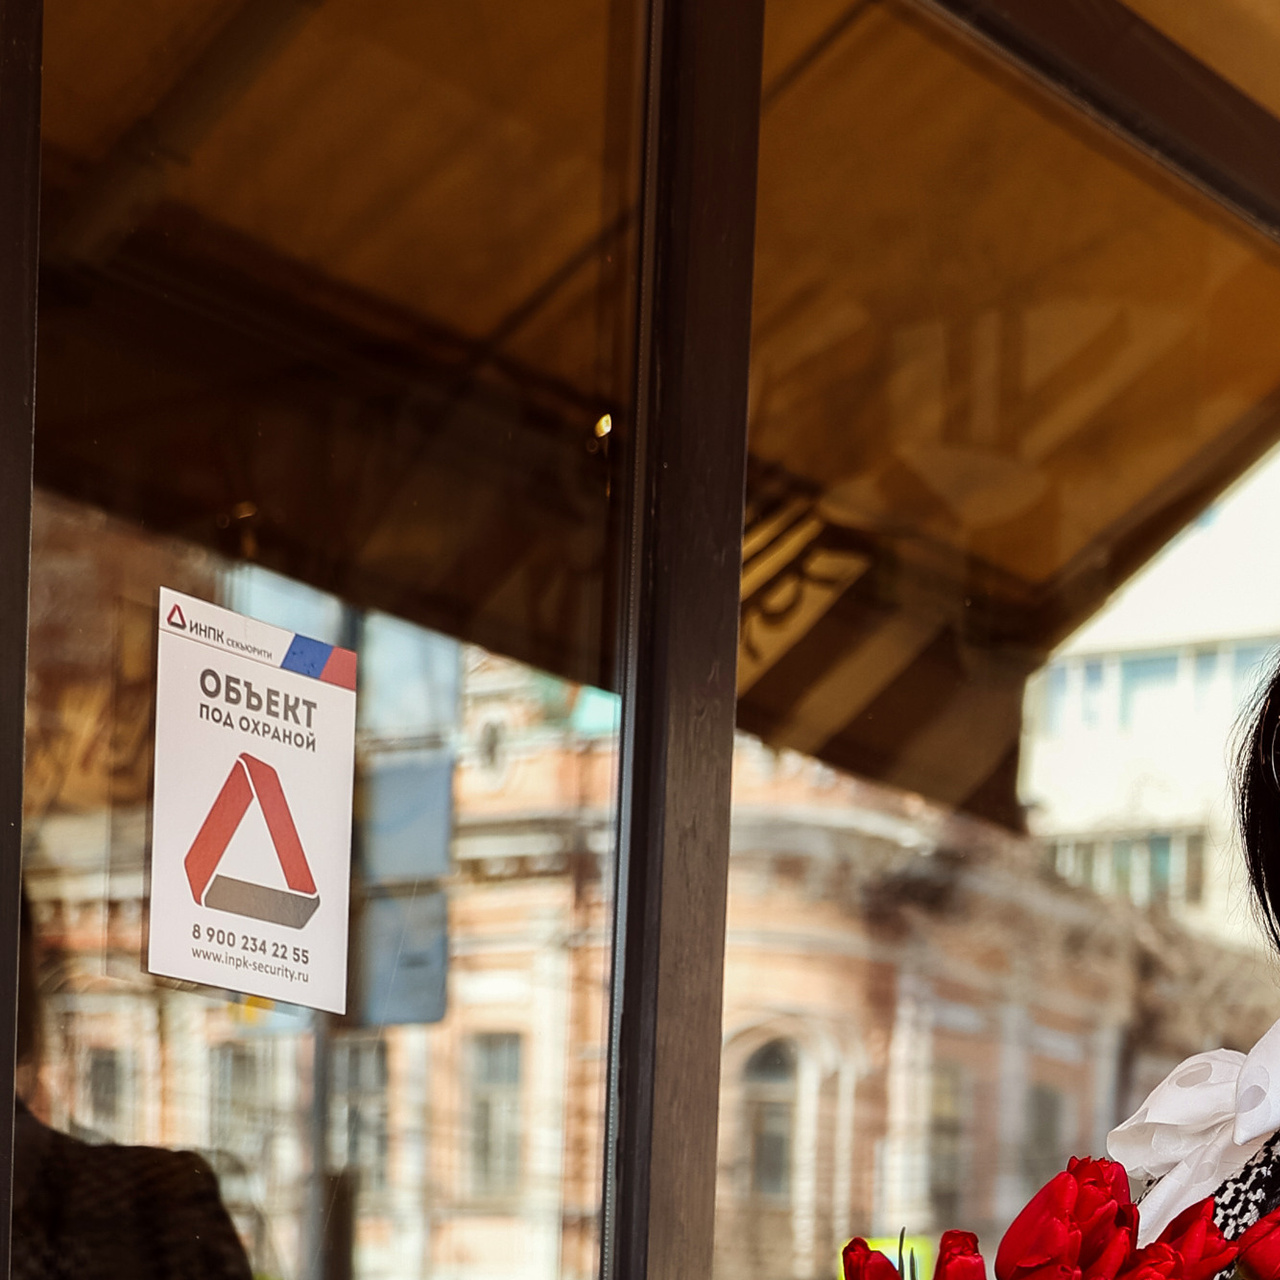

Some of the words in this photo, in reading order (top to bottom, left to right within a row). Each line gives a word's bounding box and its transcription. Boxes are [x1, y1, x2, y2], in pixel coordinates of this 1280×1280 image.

[189, 620, 225, 643] ИНПК
[200, 668, 317, 728] ОБЪЕКТ
[199, 703, 235, 730] ПОД
[238, 715, 316, 752] ОХРАНОЙ
[192, 923, 201, 940] 8
[206, 927, 236, 947] 900
[241, 935, 267, 955] 234
[271, 942, 288, 959] 22
[292, 947, 310, 964] 55
[192, 947, 309, 982] www.inpk-security.ru
